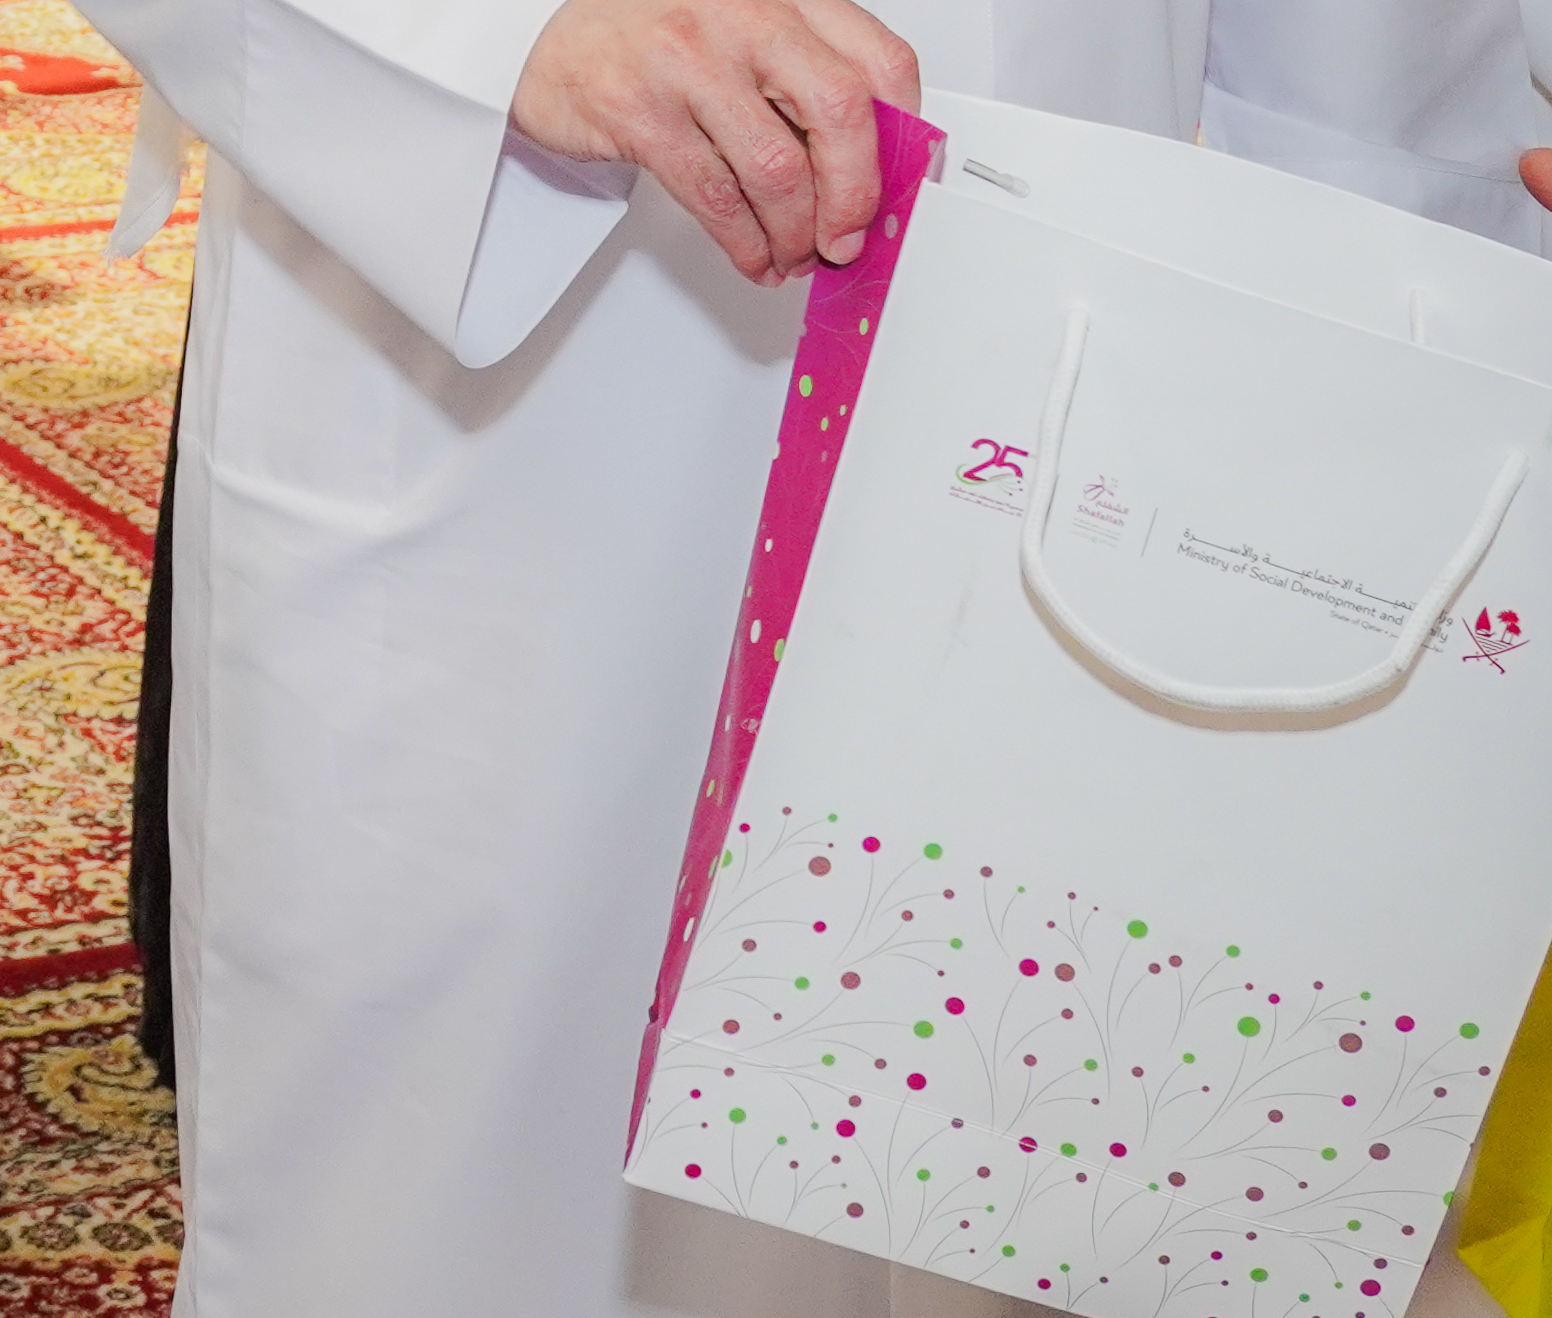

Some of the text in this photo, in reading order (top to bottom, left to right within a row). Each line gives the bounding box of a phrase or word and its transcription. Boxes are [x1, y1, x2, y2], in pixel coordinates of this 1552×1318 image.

[962, 438, 1029, 482] 25
[1076, 504, 1125, 527] Shafallah
[1177, 543, 1230, 572] Ministry
[1232, 563, 1249, 574] of
[1249, 566, 1289, 589] Social
[1290, 580, 1377, 617] Development
[1379, 612, 1405, 626] and
